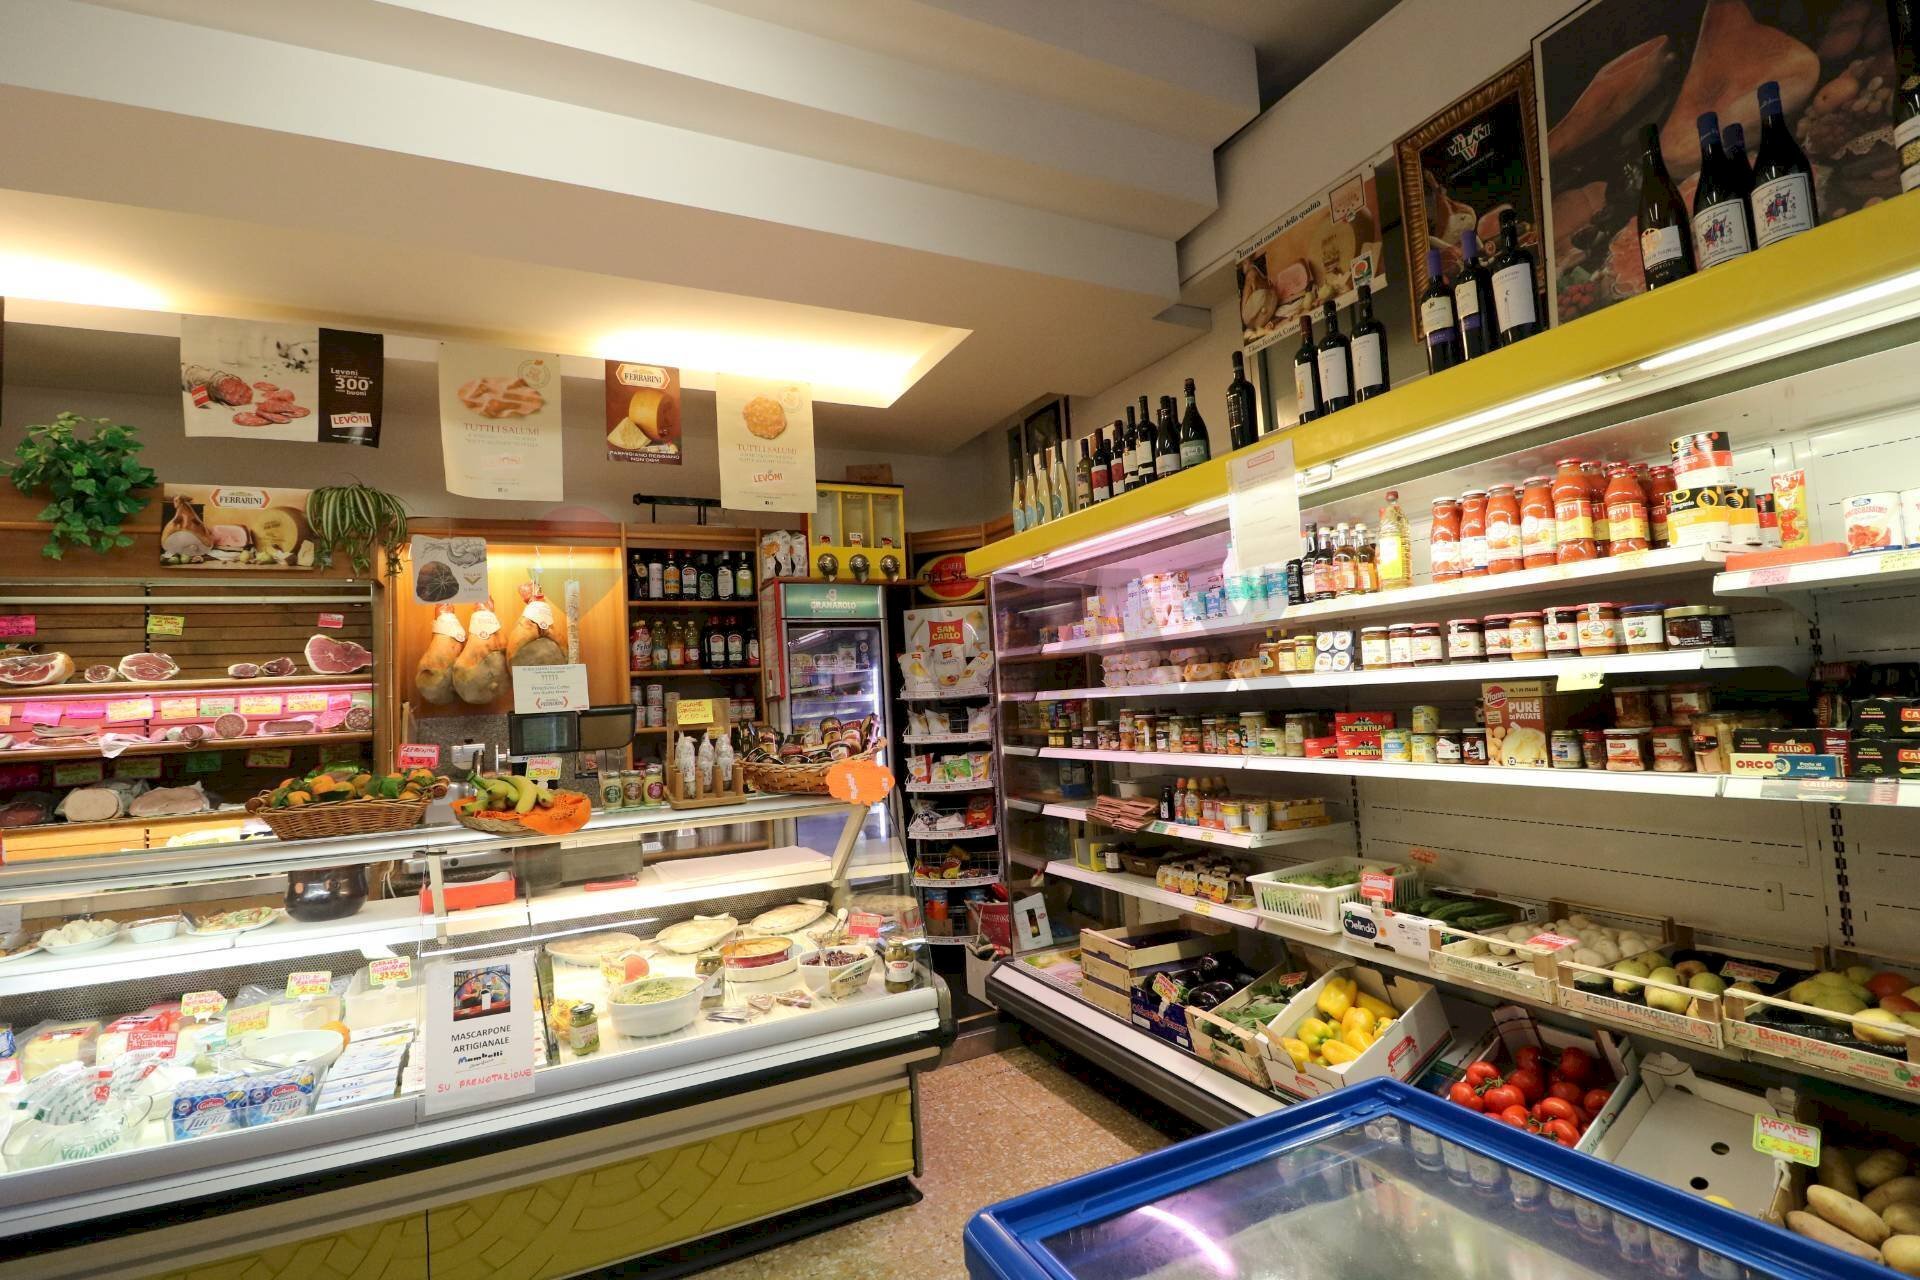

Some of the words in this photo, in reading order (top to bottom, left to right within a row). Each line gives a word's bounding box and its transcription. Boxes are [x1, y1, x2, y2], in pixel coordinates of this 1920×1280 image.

[1447, 123, 1491, 157] VILLANI
[1284, 215, 1299, 228] della
[331, 367, 358, 376] Levoni
[623, 372, 662, 384] FERRARINI
[333, 415, 370, 425] LEVONI
[464, 423, 495, 433] TUTTI
[502, 425, 540, 436] SALUMI
[609, 450, 648, 458] PARMIGIANO
[649, 452, 680, 460] REGGIANO
[753, 472, 783, 483] LEVONI
[220, 495, 262, 505] FERRARINI
[923, 573, 944, 585] DEL
[810, 601, 857, 609] GRANAROLO
[932, 631, 960, 640] CARLO
[1516, 712, 1541, 720] PATATE
[1771, 744, 1812, 753] CALLIPO
[1735, 760, 1774, 769] ORCO
[1344, 919, 1376, 935] Melinda
[451, 1024, 512, 1042] MASCARPONE
[1757, 1027, 1801, 1048] Benzi
[452, 1036, 511, 1053] ARTIGIANALE
[437, 1083, 452, 1093] SU
[459, 1068, 533, 1089] PRENOTAZIONE
[1760, 1116, 1809, 1138] PATATE
